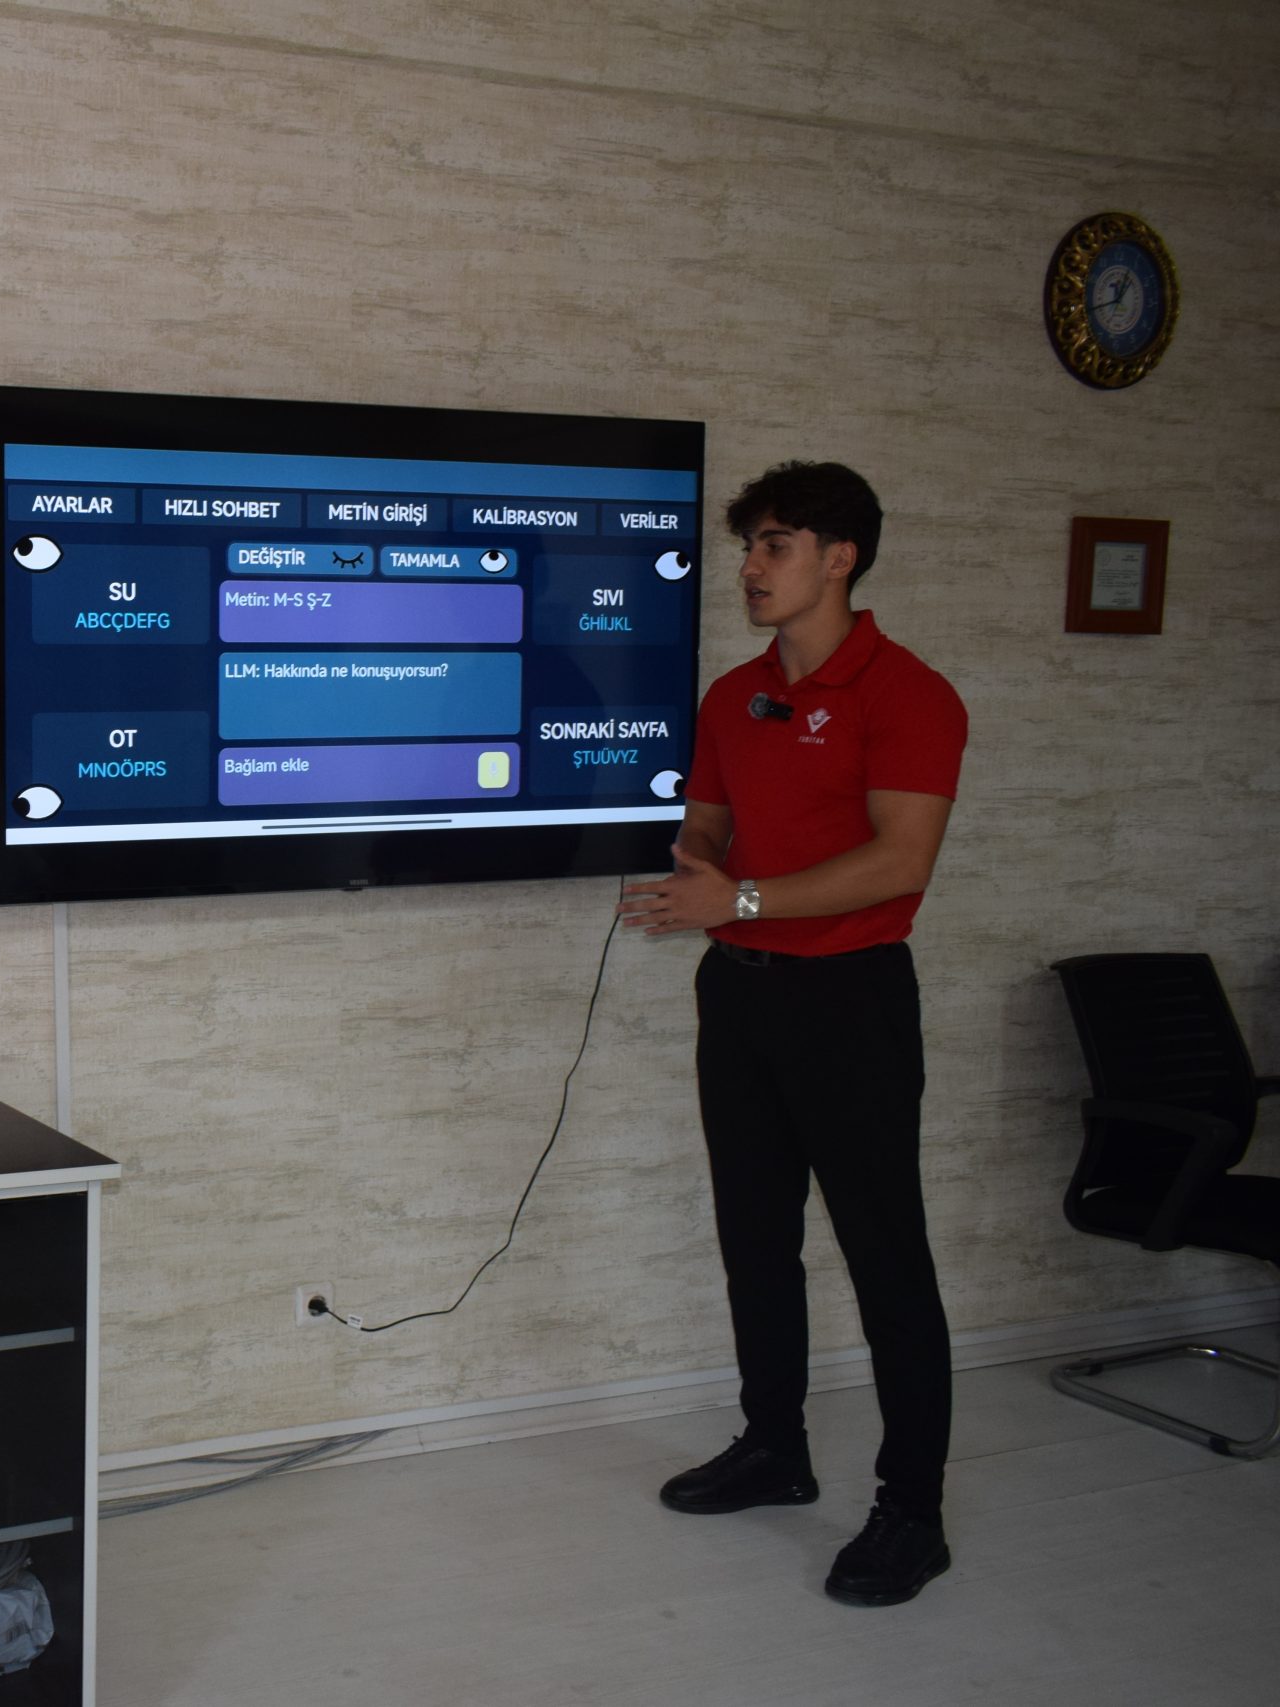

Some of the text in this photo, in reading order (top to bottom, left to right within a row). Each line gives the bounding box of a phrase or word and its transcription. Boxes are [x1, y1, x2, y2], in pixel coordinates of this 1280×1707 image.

[32, 496, 112, 513] AYARLAR
[166, 499, 280, 518] HIZLI SOHBET
[329, 502, 427, 526] METİN GİRİŞİ
[473, 507, 577, 526] KALİBRASYON
[620, 512, 677, 529] VERİLER
[239, 547, 305, 568] DEĞİŞTİR
[390, 553, 459, 567] TAMAMLA
[109, 582, 135, 601] SU
[593, 589, 623, 606] SIVI
[226, 592, 331, 610] Metin: M-S Ş-Z
[75, 613, 170, 632] ABCÇDEFG
[226, 663, 448, 680] LLM: Hakkında ne konuşuyorsun?
[540, 719, 668, 739] SONRAKİ SAYFA
[110, 730, 137, 747] OT
[225, 758, 309, 776] Bağlam ekle
[574, 748, 637, 768] ŞTUÜVYZ
[79, 759, 166, 777] MNOÖPRS
